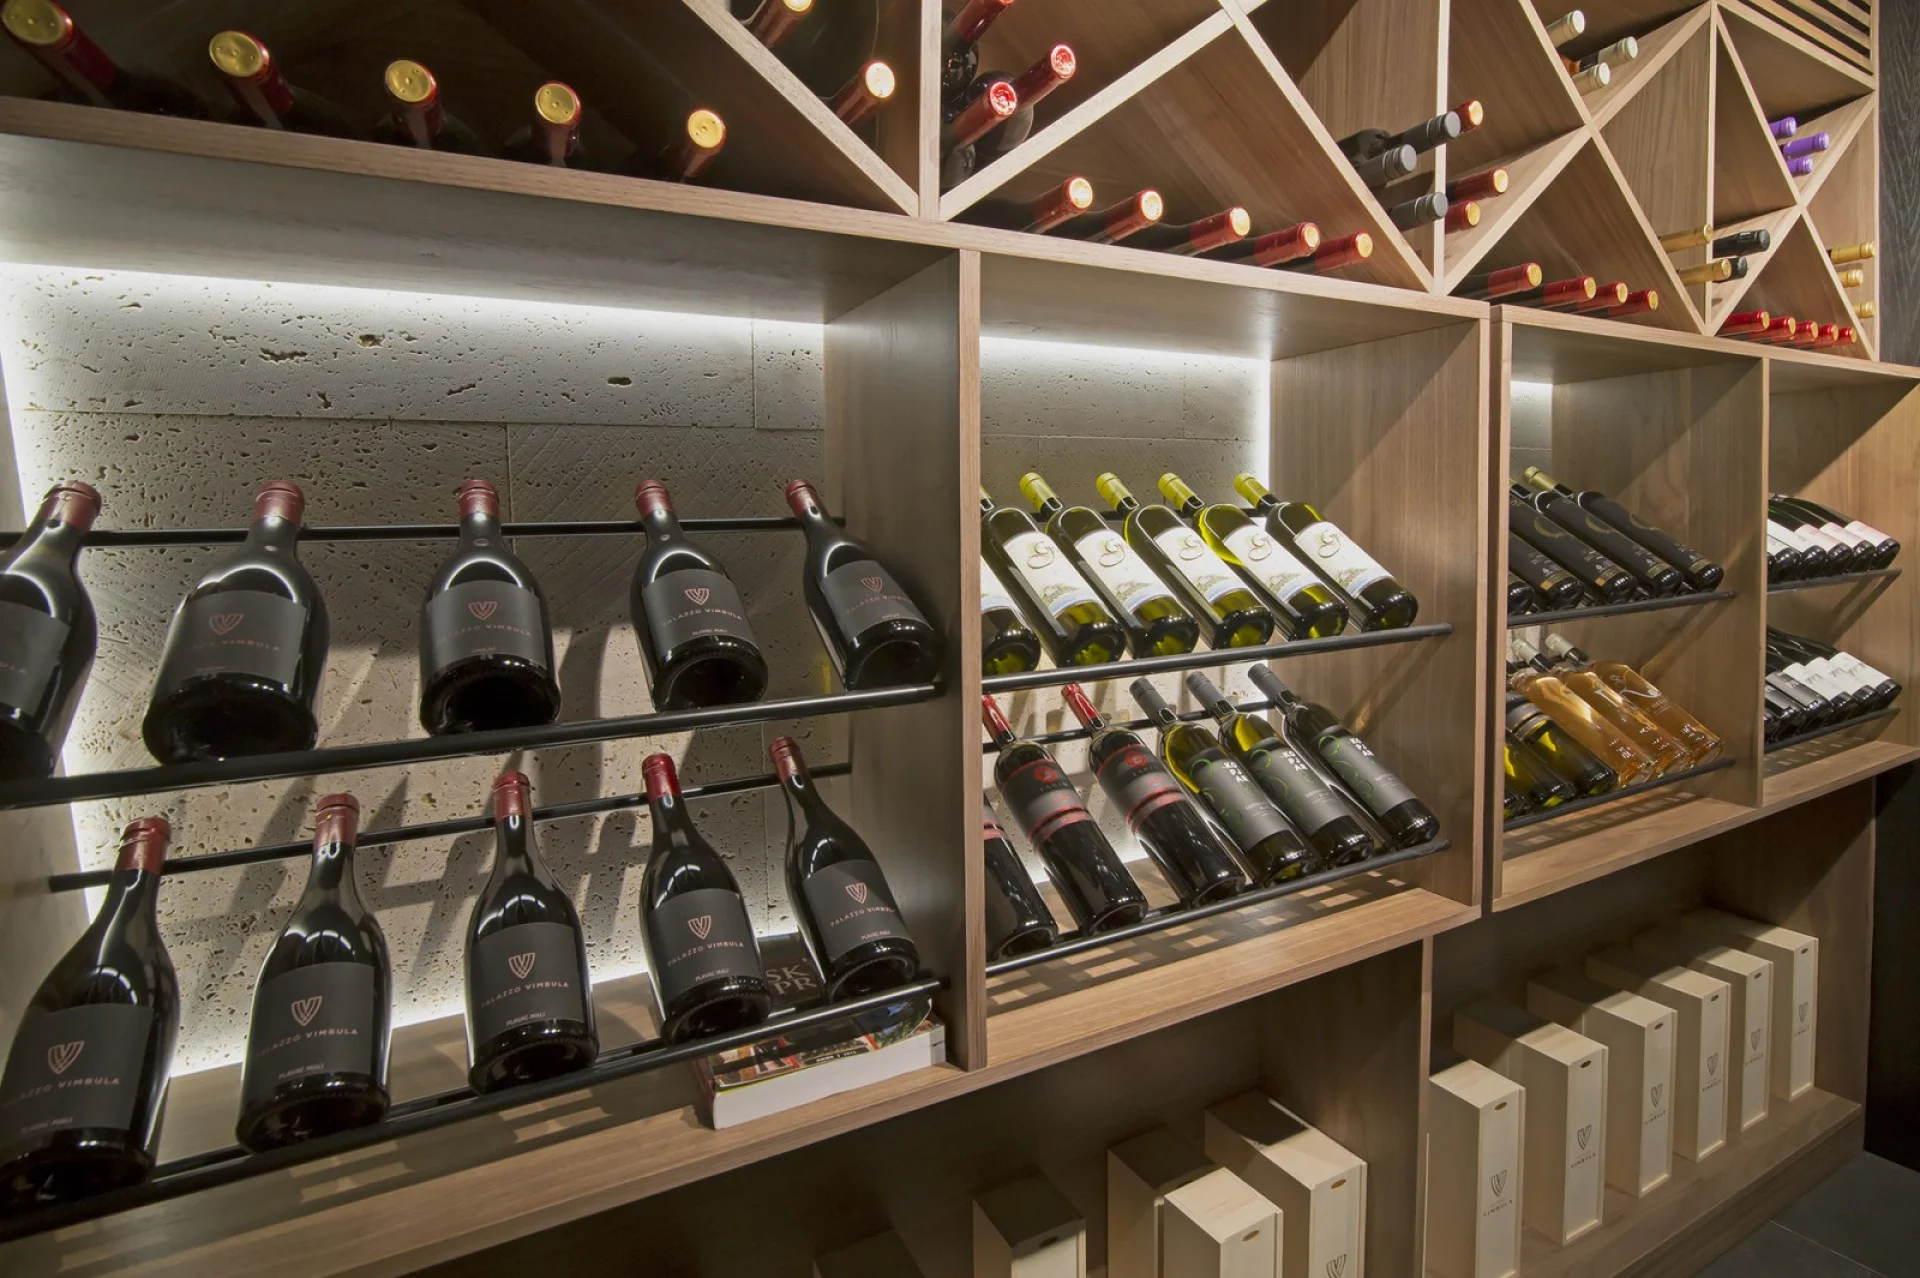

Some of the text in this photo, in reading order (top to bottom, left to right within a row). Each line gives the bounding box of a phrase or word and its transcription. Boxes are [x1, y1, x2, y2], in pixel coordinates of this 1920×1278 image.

[707, 941, 745, 949] VIMBULA
[525, 981, 569, 991] VIMBULA
[306, 1028, 358, 1039] VIMBULA
[58, 1077, 120, 1089] VIMBULA
